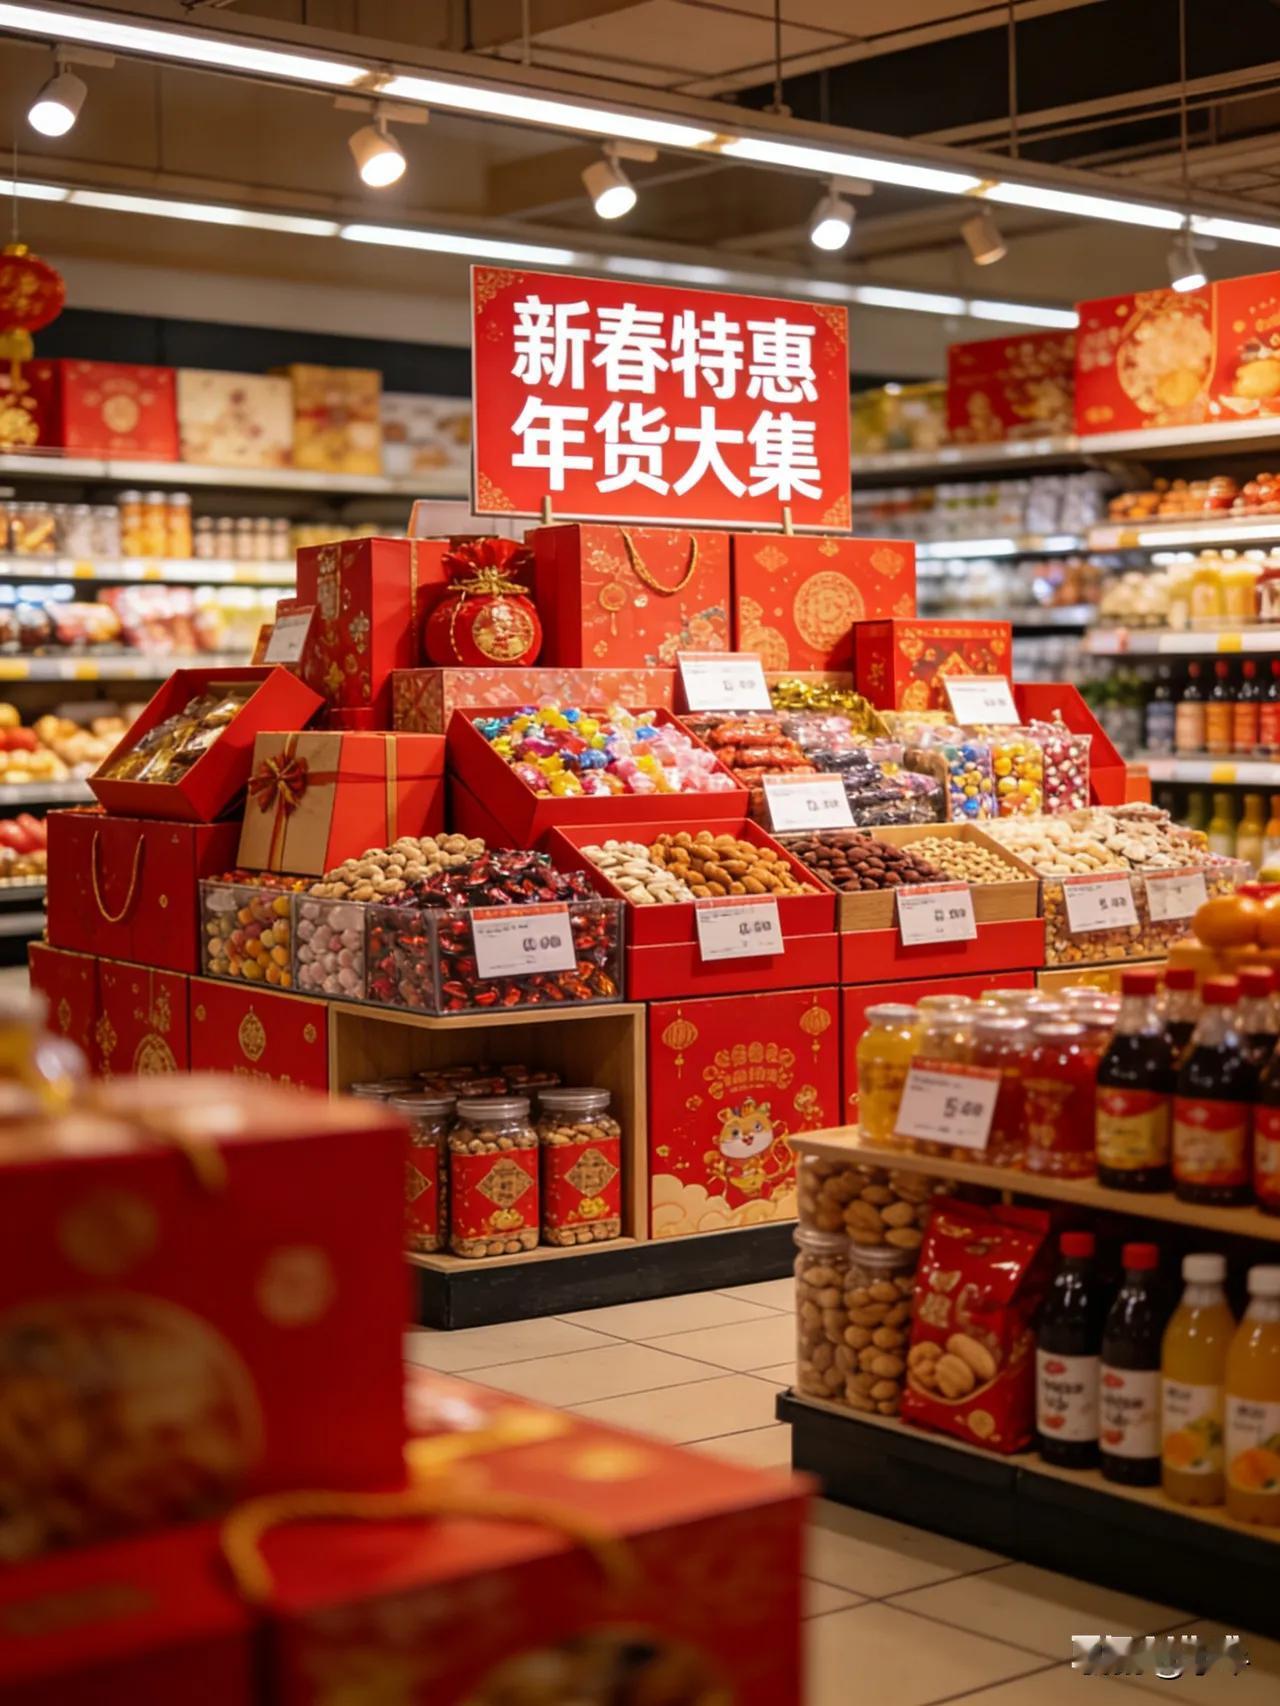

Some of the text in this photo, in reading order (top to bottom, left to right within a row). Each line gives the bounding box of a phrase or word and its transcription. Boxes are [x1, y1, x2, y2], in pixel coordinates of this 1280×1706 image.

[511, 295, 818, 403] 新春特惠
[511, 395, 822, 502] 年货大集
